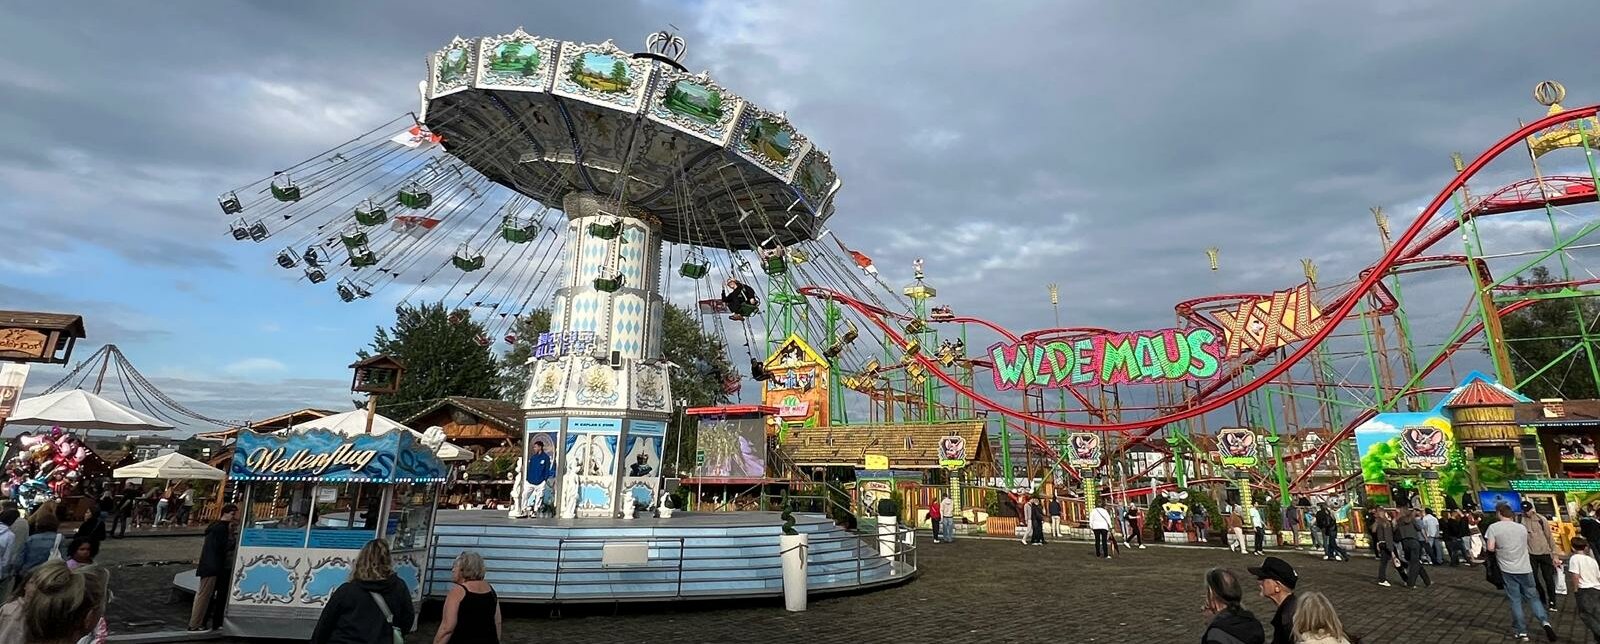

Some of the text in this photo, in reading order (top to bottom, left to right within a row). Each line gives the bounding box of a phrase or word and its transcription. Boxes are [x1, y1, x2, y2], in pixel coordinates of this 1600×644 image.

[992, 281, 1327, 387] WILDE MAUS XXL
[246, 443, 377, 475] Wellenflug
